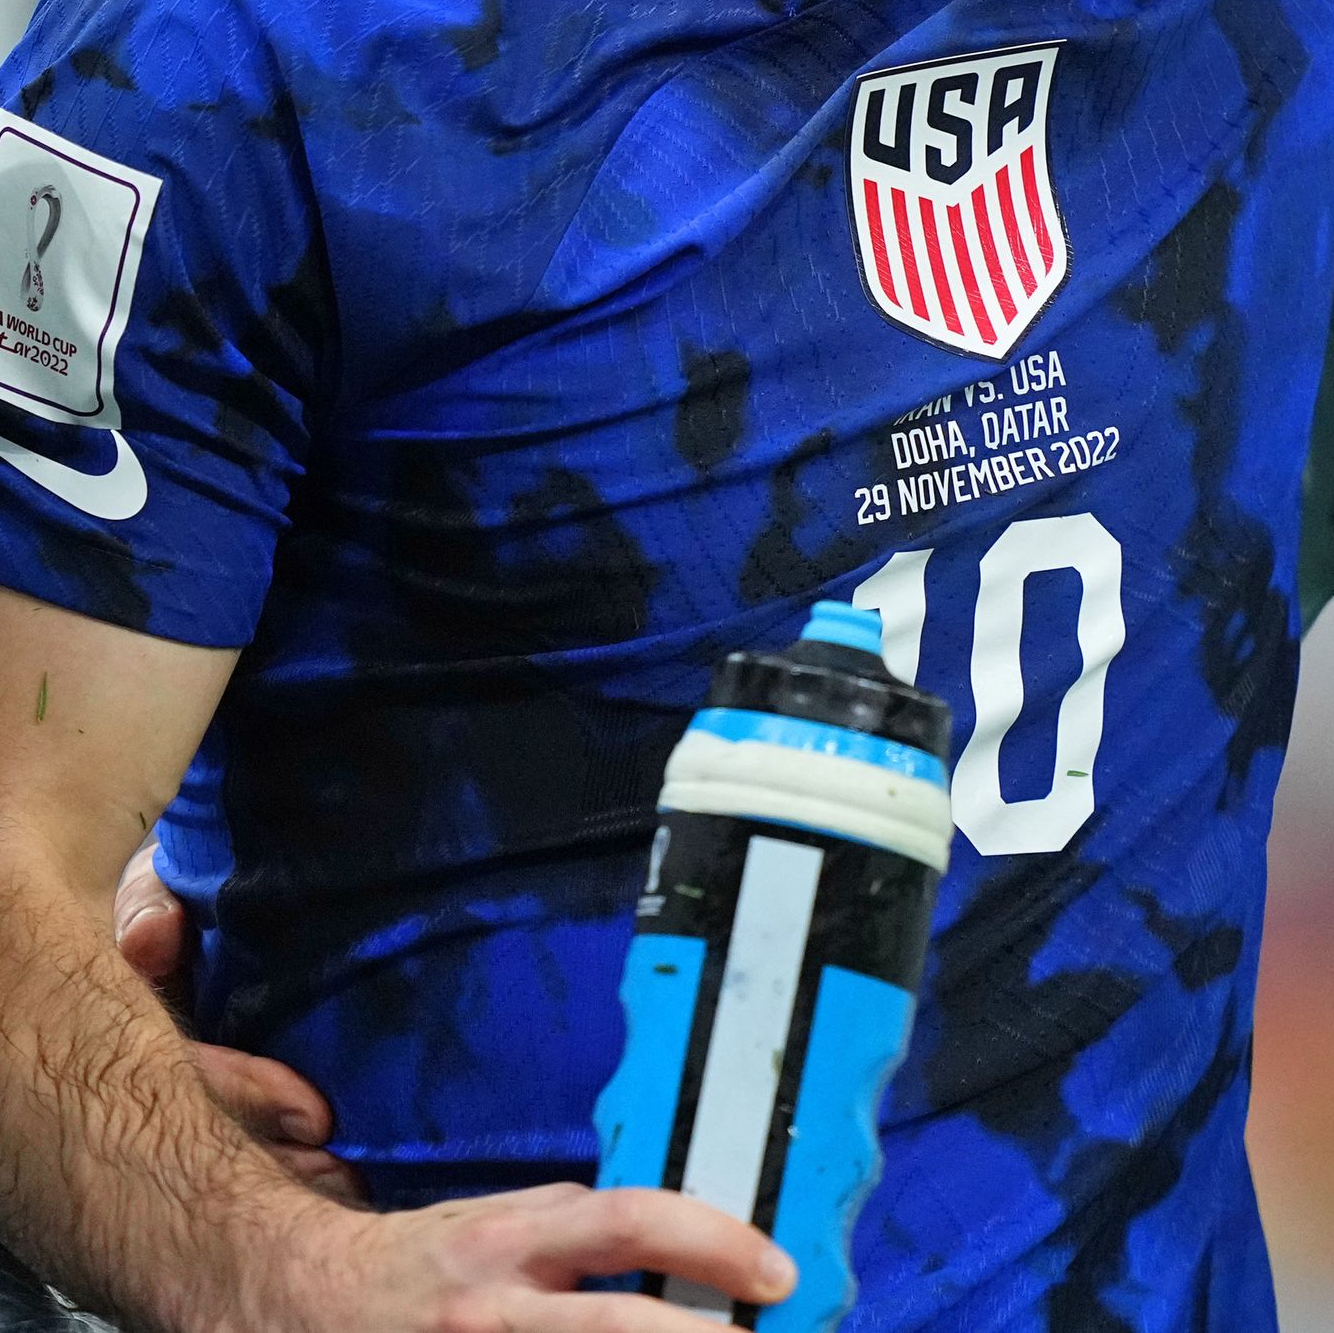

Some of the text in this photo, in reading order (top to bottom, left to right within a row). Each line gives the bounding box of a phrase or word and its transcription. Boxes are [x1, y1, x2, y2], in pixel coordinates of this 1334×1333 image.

[863, 60, 1044, 186] USA
[7, 314, 51, 346] WORLD
[53, 337, 77, 357] CUP
[893, 394, 952, 426] AN
[1010, 350, 1067, 396] USA
[891, 396, 1070, 470] DOHA, QATAR
[854, 426, 1120, 525] 29 NOVEMBER 2022
